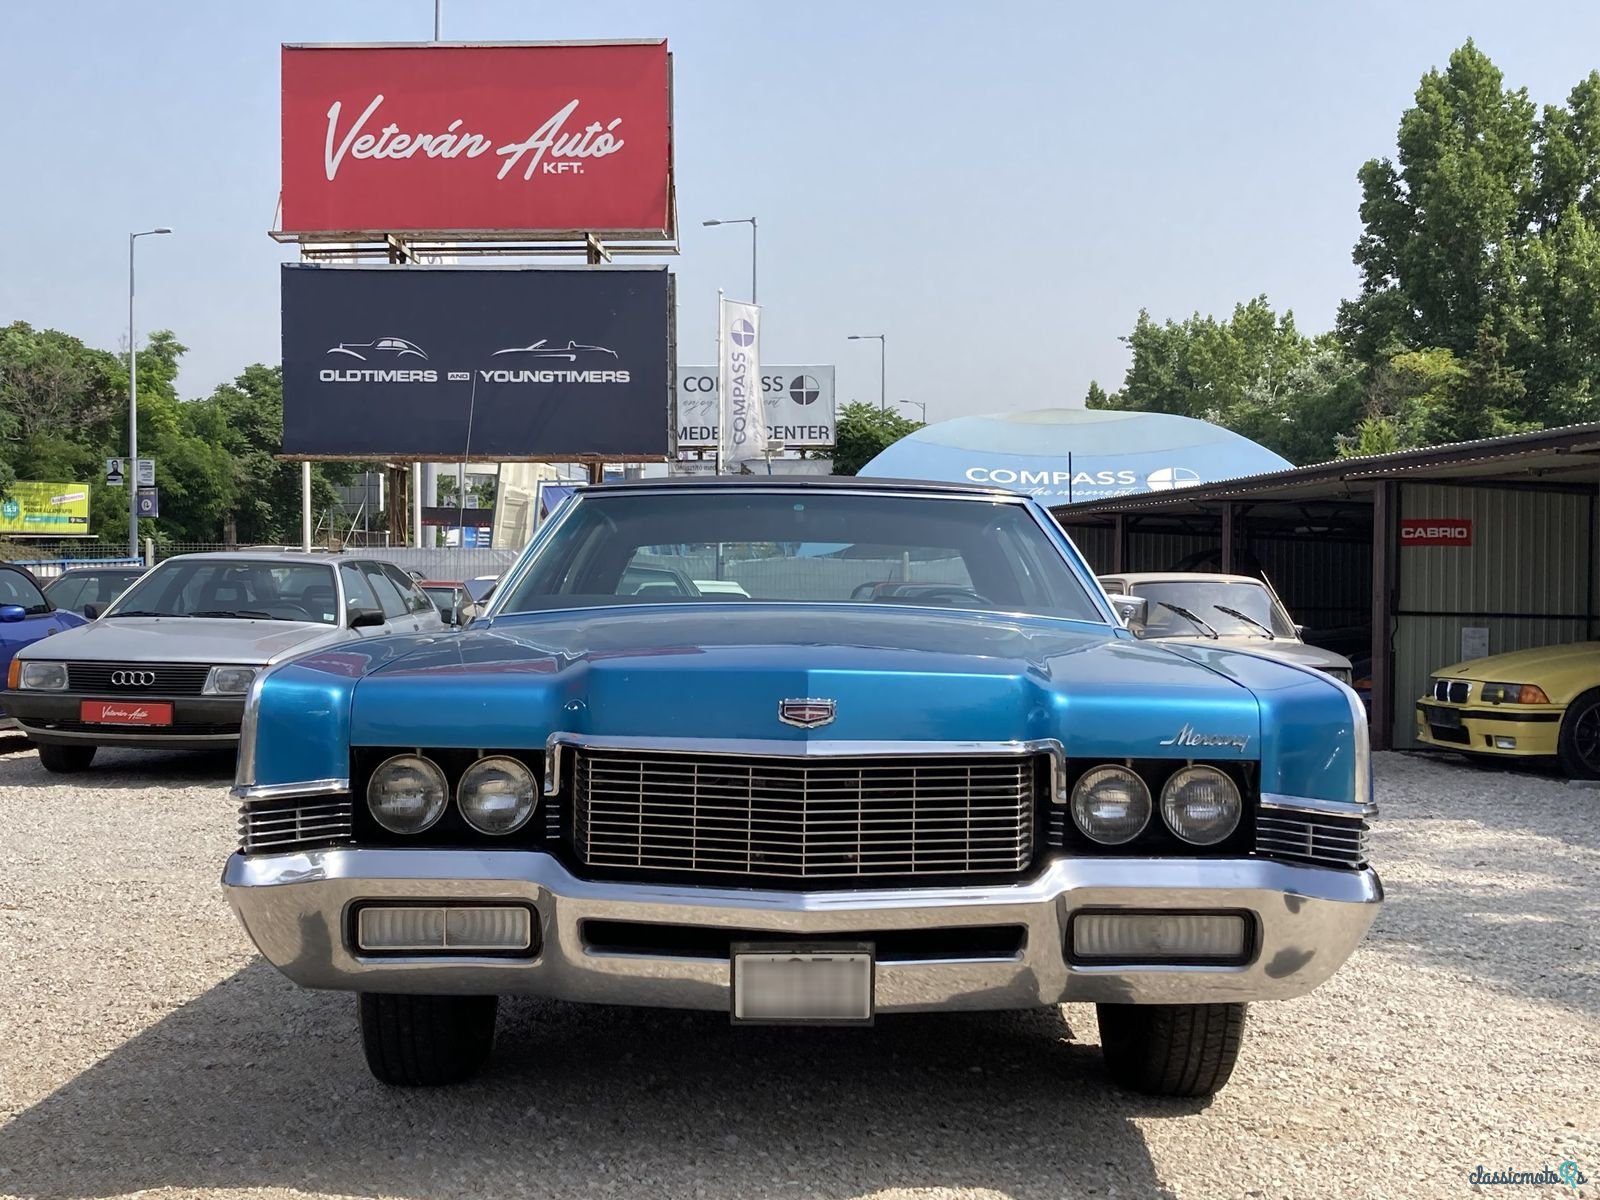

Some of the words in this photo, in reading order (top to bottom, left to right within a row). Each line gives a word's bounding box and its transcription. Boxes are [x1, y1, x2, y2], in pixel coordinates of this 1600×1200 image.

[325, 94, 491, 181] Veterán
[496, 99, 625, 181] Autó
[543, 162, 584, 174] KFT.
[319, 369, 438, 383] OLDTIMERS
[449, 372, 469, 381] AND
[480, 370, 631, 384] YOUNGTIMERS
[683, 375, 784, 392] COSS
[731, 352, 746, 445] COMPASS
[966, 467, 1136, 485] COMPASS
[1401, 527, 1467, 538] CABRIO
[1160, 722, 1251, 753] Mercury
